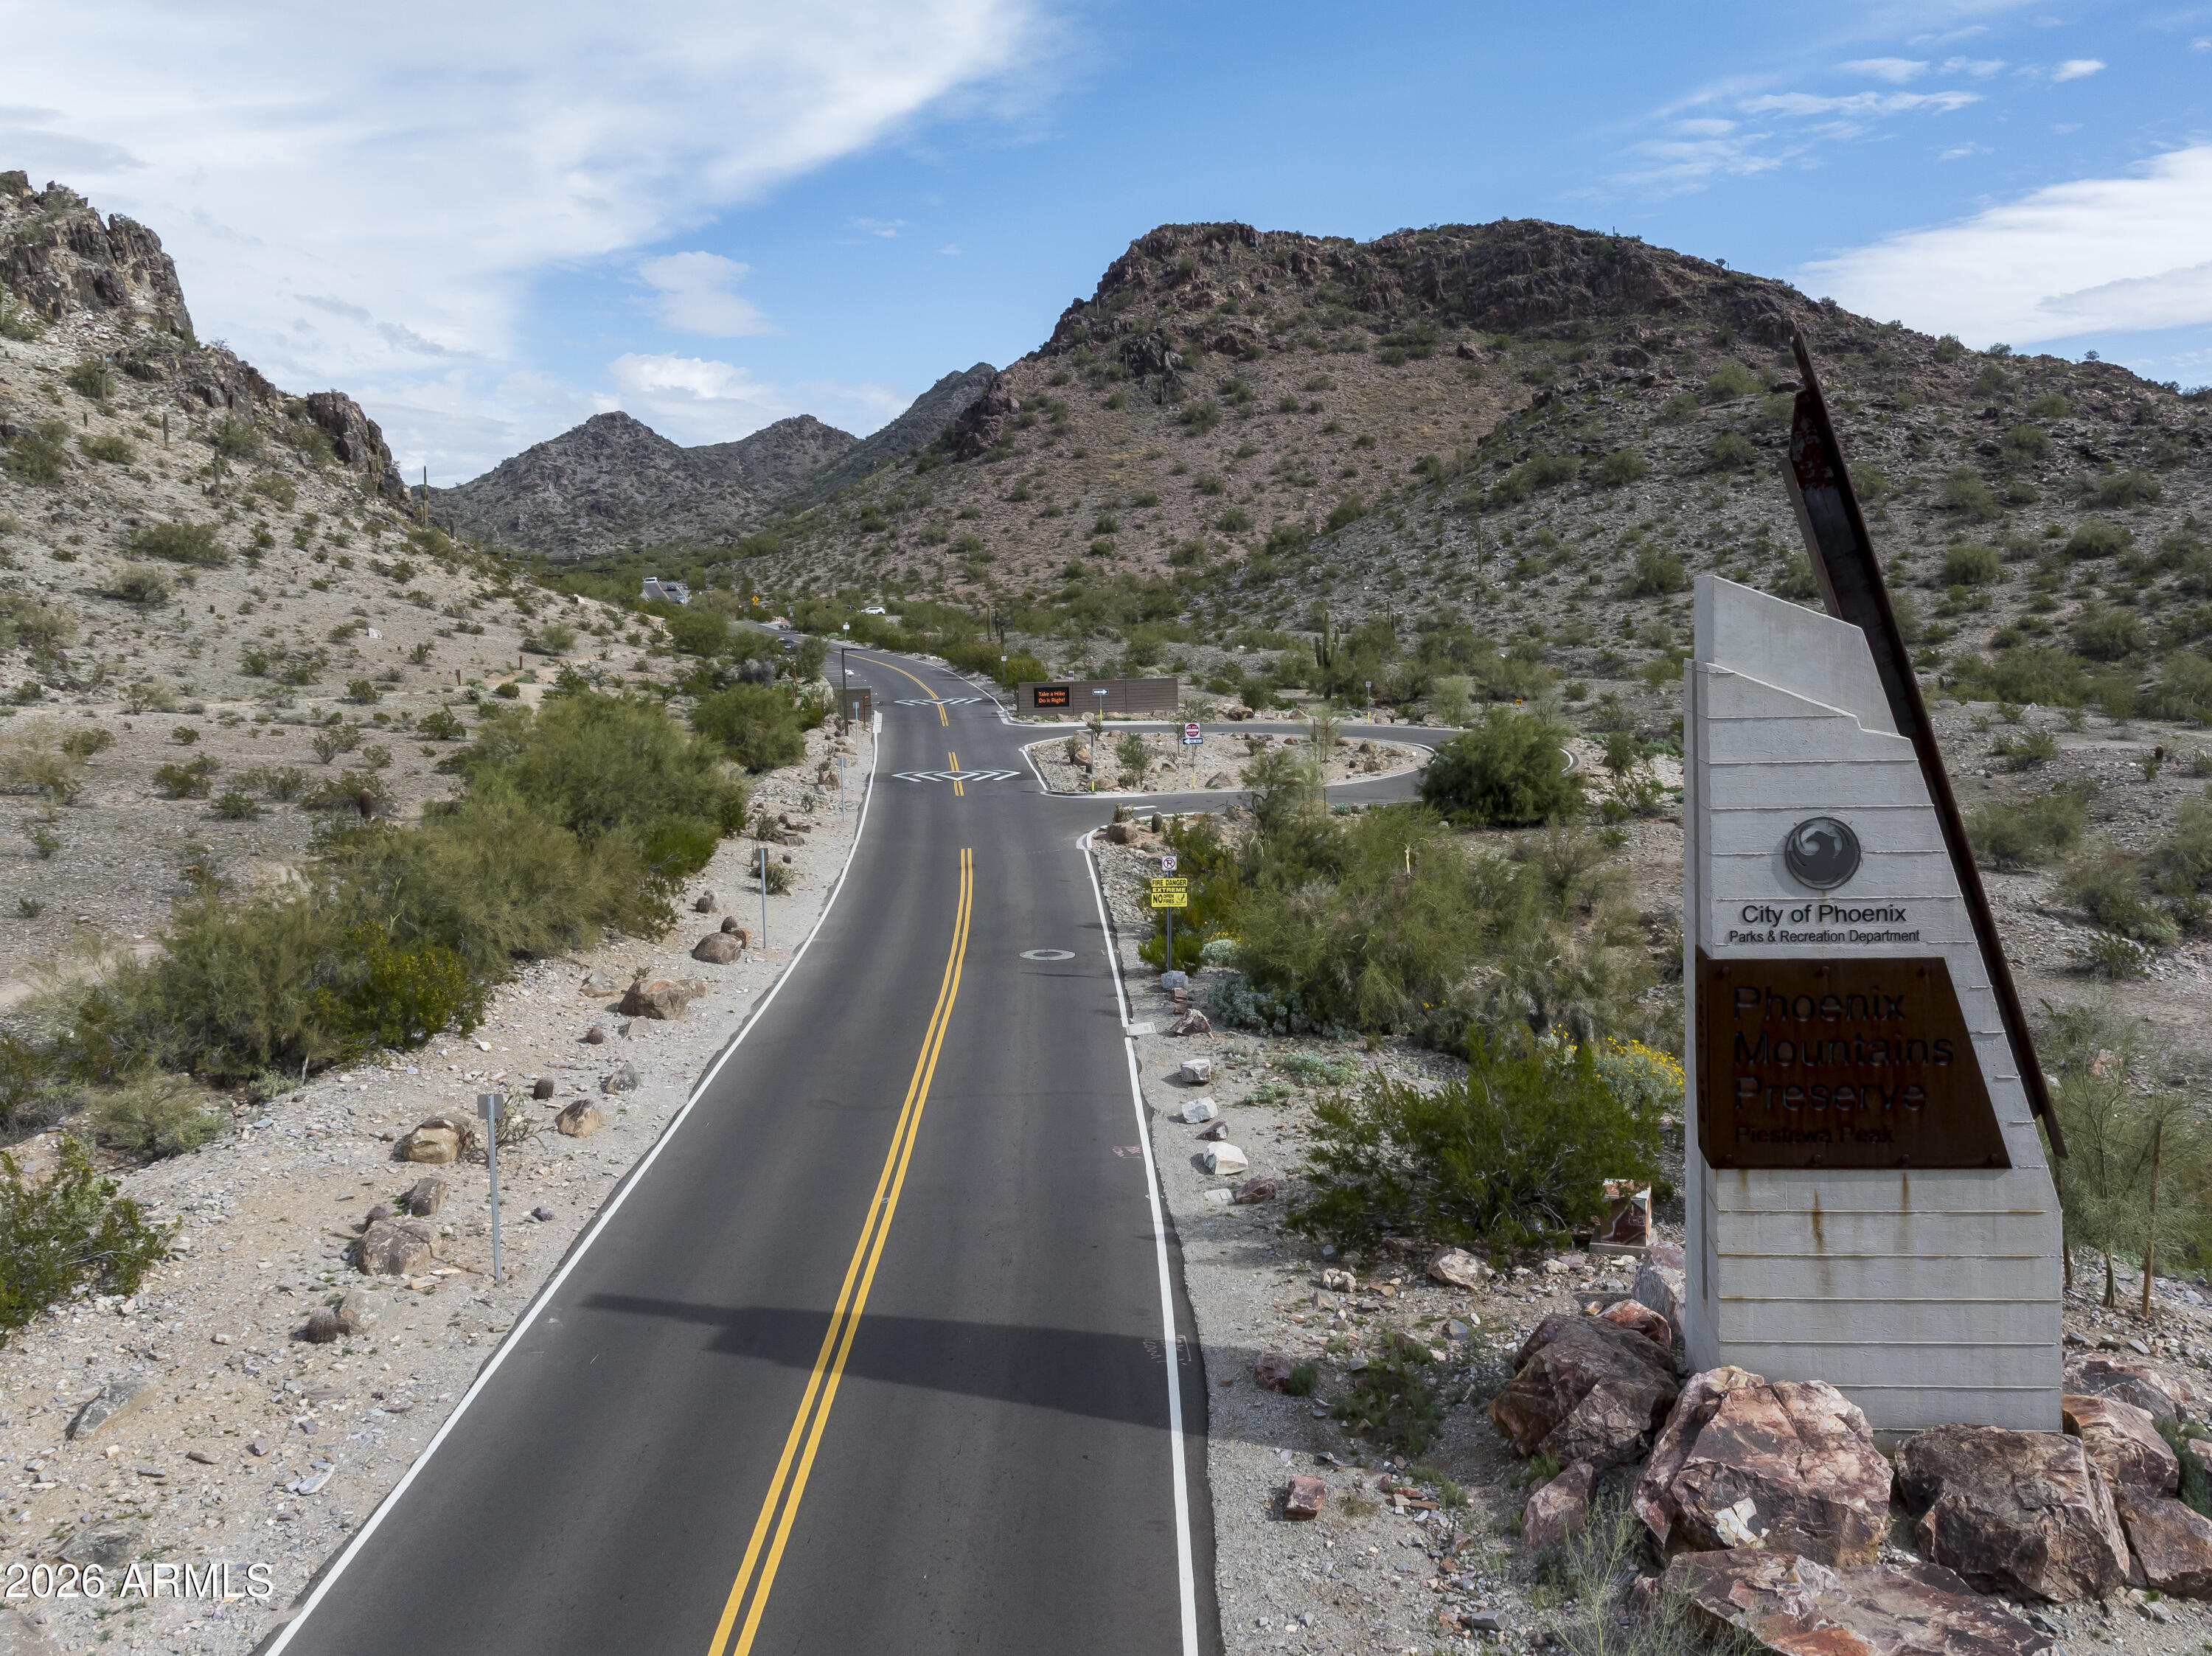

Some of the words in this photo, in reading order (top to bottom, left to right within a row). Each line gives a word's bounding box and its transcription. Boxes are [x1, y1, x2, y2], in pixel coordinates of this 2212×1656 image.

[1153, 894, 1163, 903] NO
[1742, 905, 1784, 927] City
[1790, 904, 1812, 922] of
[1818, 904, 1907, 922] Phoenix
[1729, 930, 1764, 942] Parks
[1767, 930, 1776, 942] &
[1780, 929, 1845, 942] Recreation
[1849, 929, 1920, 944] Department
[1733, 985, 1905, 1022] Phoenix
[1733, 1031, 1954, 1066] Mountains
[1734, 1076, 1927, 1111] Preserve
[1735, 1126, 1832, 1144] Piestewa
[1840, 1126, 1894, 1144] Peak
